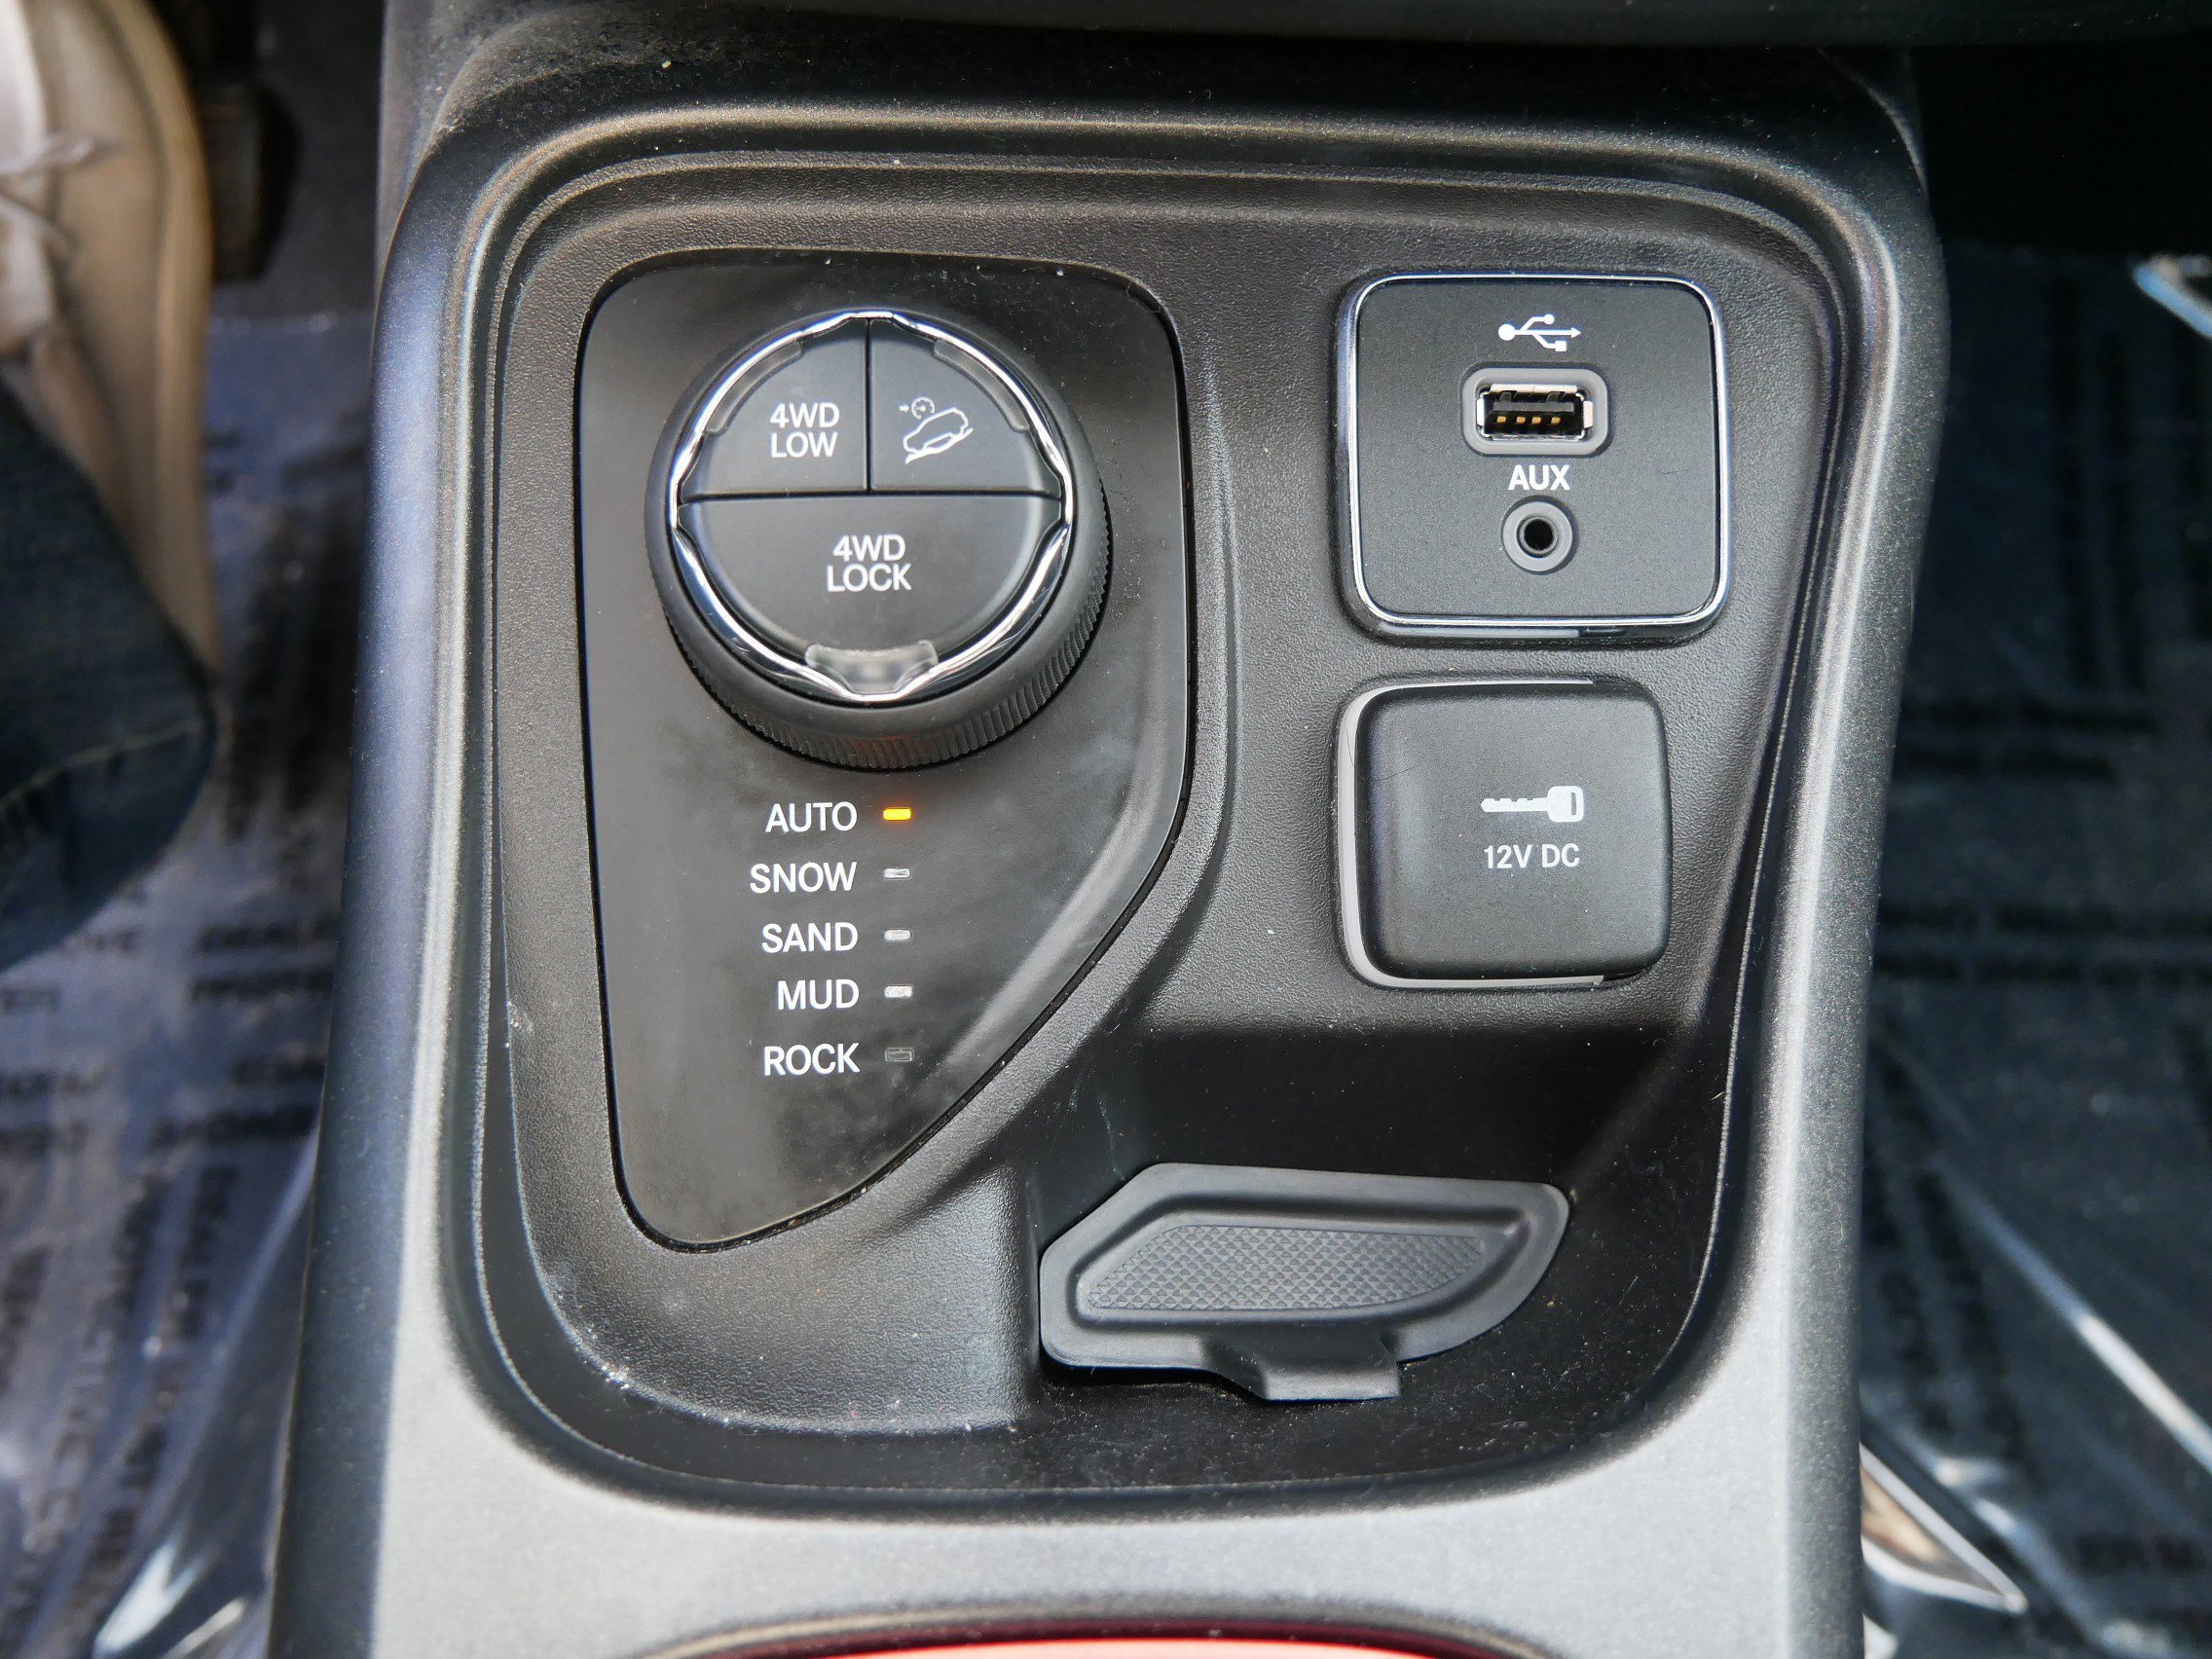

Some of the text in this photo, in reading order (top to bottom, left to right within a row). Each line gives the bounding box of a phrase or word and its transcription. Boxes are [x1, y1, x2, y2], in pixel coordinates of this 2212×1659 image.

[770, 402, 839, 428] 4WD
[770, 432, 838, 458] LOW
[1508, 464, 1570, 491] AUX
[832, 534, 906, 560] 4WD
[826, 564, 912, 592] LOCK
[765, 801, 858, 832] AUTO
[1484, 843, 1580, 869] 12V DC
[750, 862, 857, 894] SNOW
[761, 922, 859, 954] SAND
[778, 978, 860, 1010] MUD
[764, 1042, 860, 1076] ROCK
